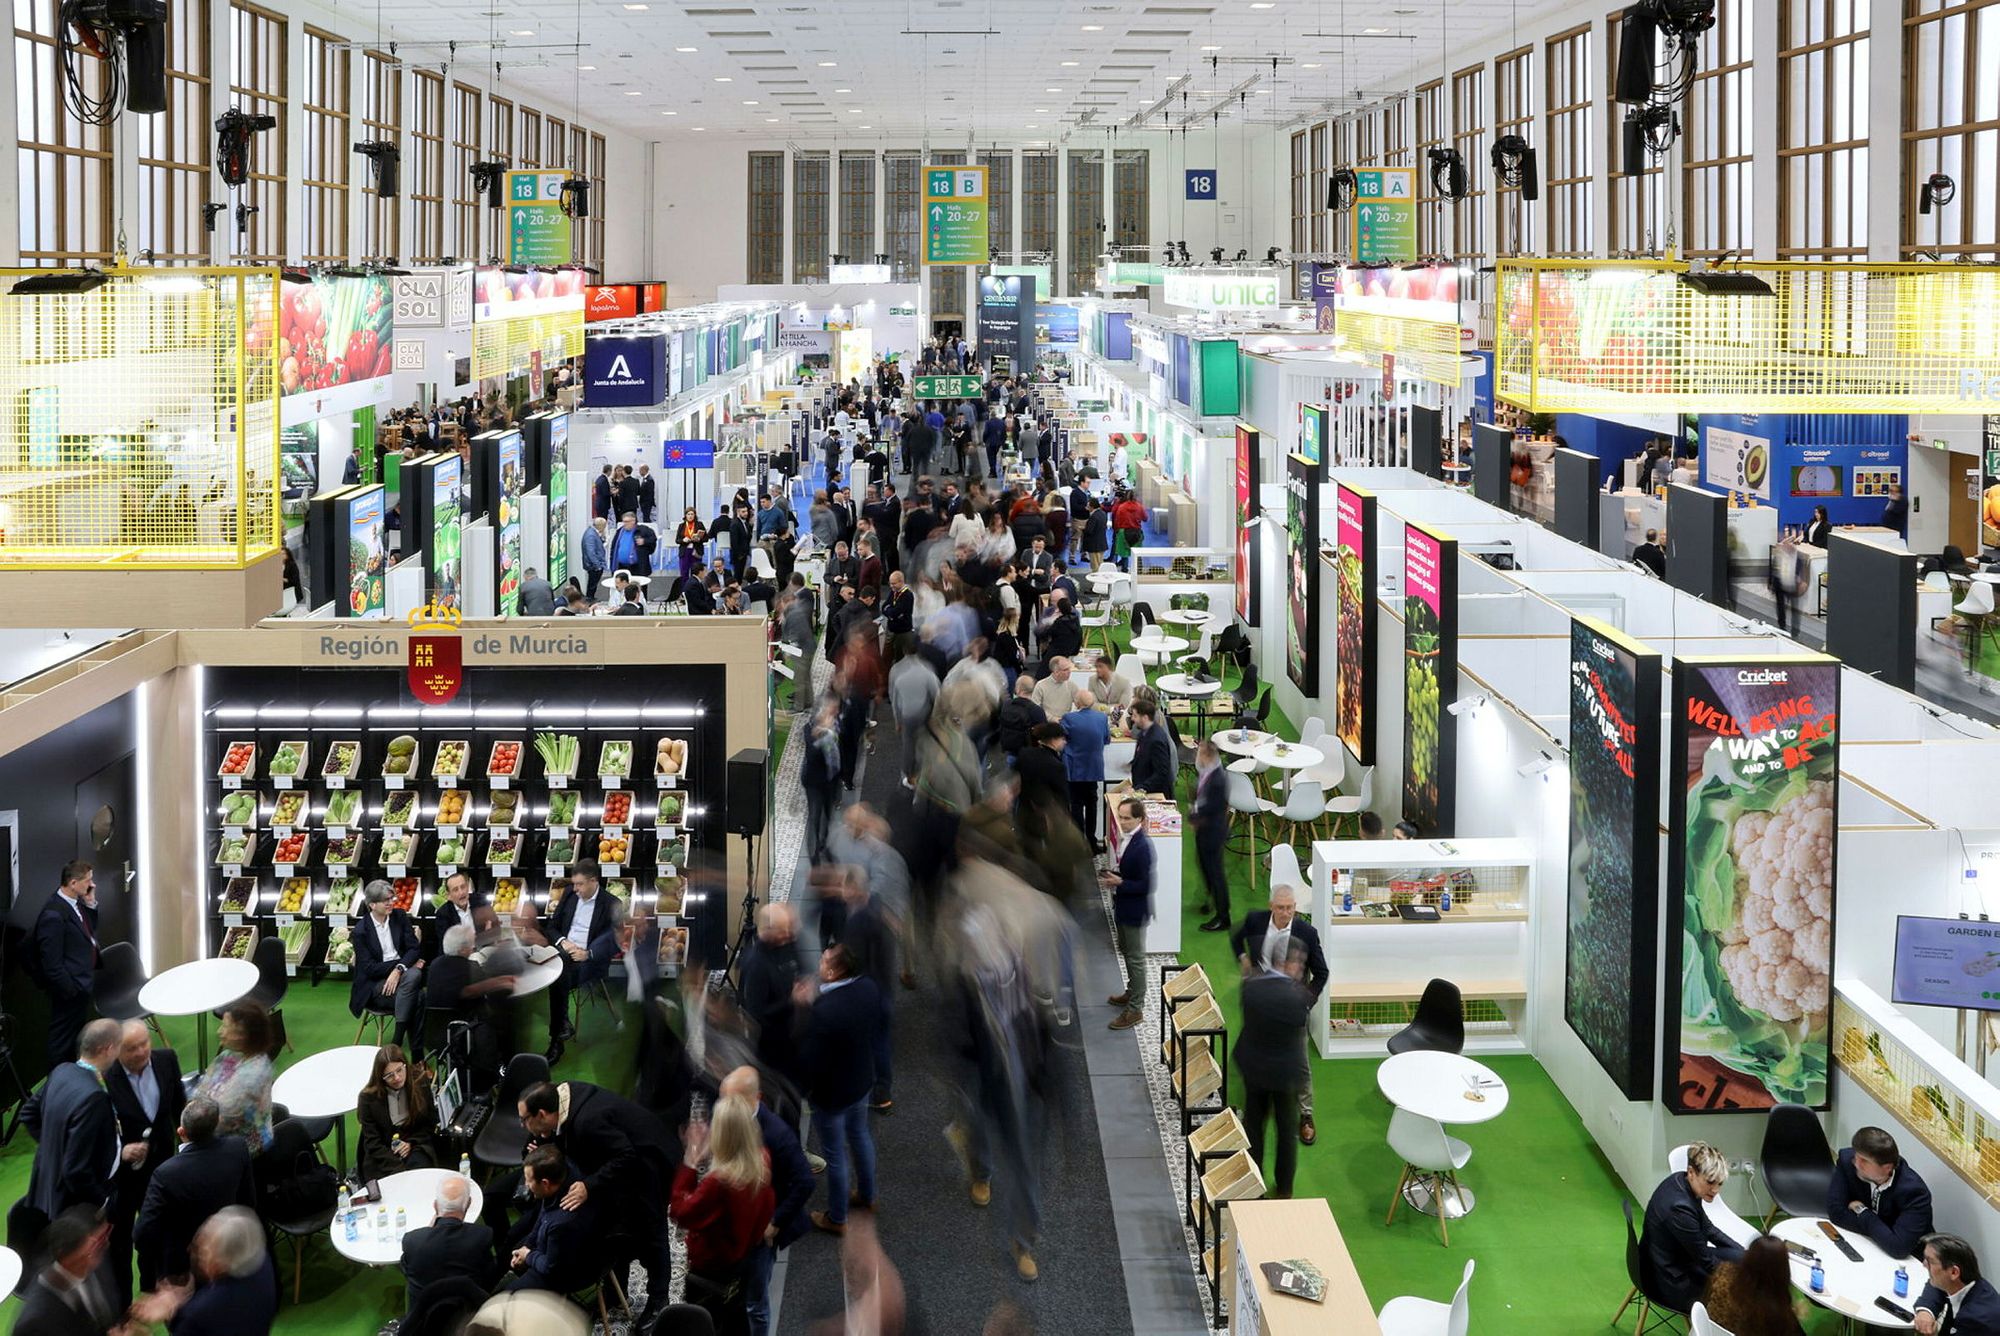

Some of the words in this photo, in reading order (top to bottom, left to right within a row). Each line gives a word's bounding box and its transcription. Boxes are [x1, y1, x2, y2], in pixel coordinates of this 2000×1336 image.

[516, 185, 533, 198] 18
[546, 183, 557, 197] C
[932, 180, 950, 194] 18
[964, 180, 974, 193] B
[1190, 176, 1211, 193] 18
[1361, 182, 1379, 195] 18
[1391, 181, 1404, 194] A
[399, 281, 437, 297] CLA
[398, 301, 437, 317] SOL
[590, 304, 620, 313] lapalma
[399, 345, 421, 354] CLA
[399, 356, 421, 365] SOL
[1407, 546, 1427, 563] production
[1427, 556, 1435, 568] and
[320, 635, 399, 660] Región
[473, 635, 501, 654] de
[509, 634, 587, 654] Murcia
[1592, 638, 1616, 661] Cricket
[1579, 661, 1590, 679] ARE
[1738, 669, 1788, 682] Cricket
[1572, 674, 1582, 687] TO
[1581, 683, 1586, 693] A
[1585, 684, 1621, 749] FUTURE
[1709, 736, 1723, 752] A
[1728, 728, 1781, 761] WAY
[1780, 729, 1797, 741] TO
[1614, 750, 1636, 779] ALL
[1742, 763, 1765, 775] AND
[1767, 760, 1782, 771] TO
[1782, 743, 1814, 770] BE
[1947, 926, 1992, 938] GARDEN
